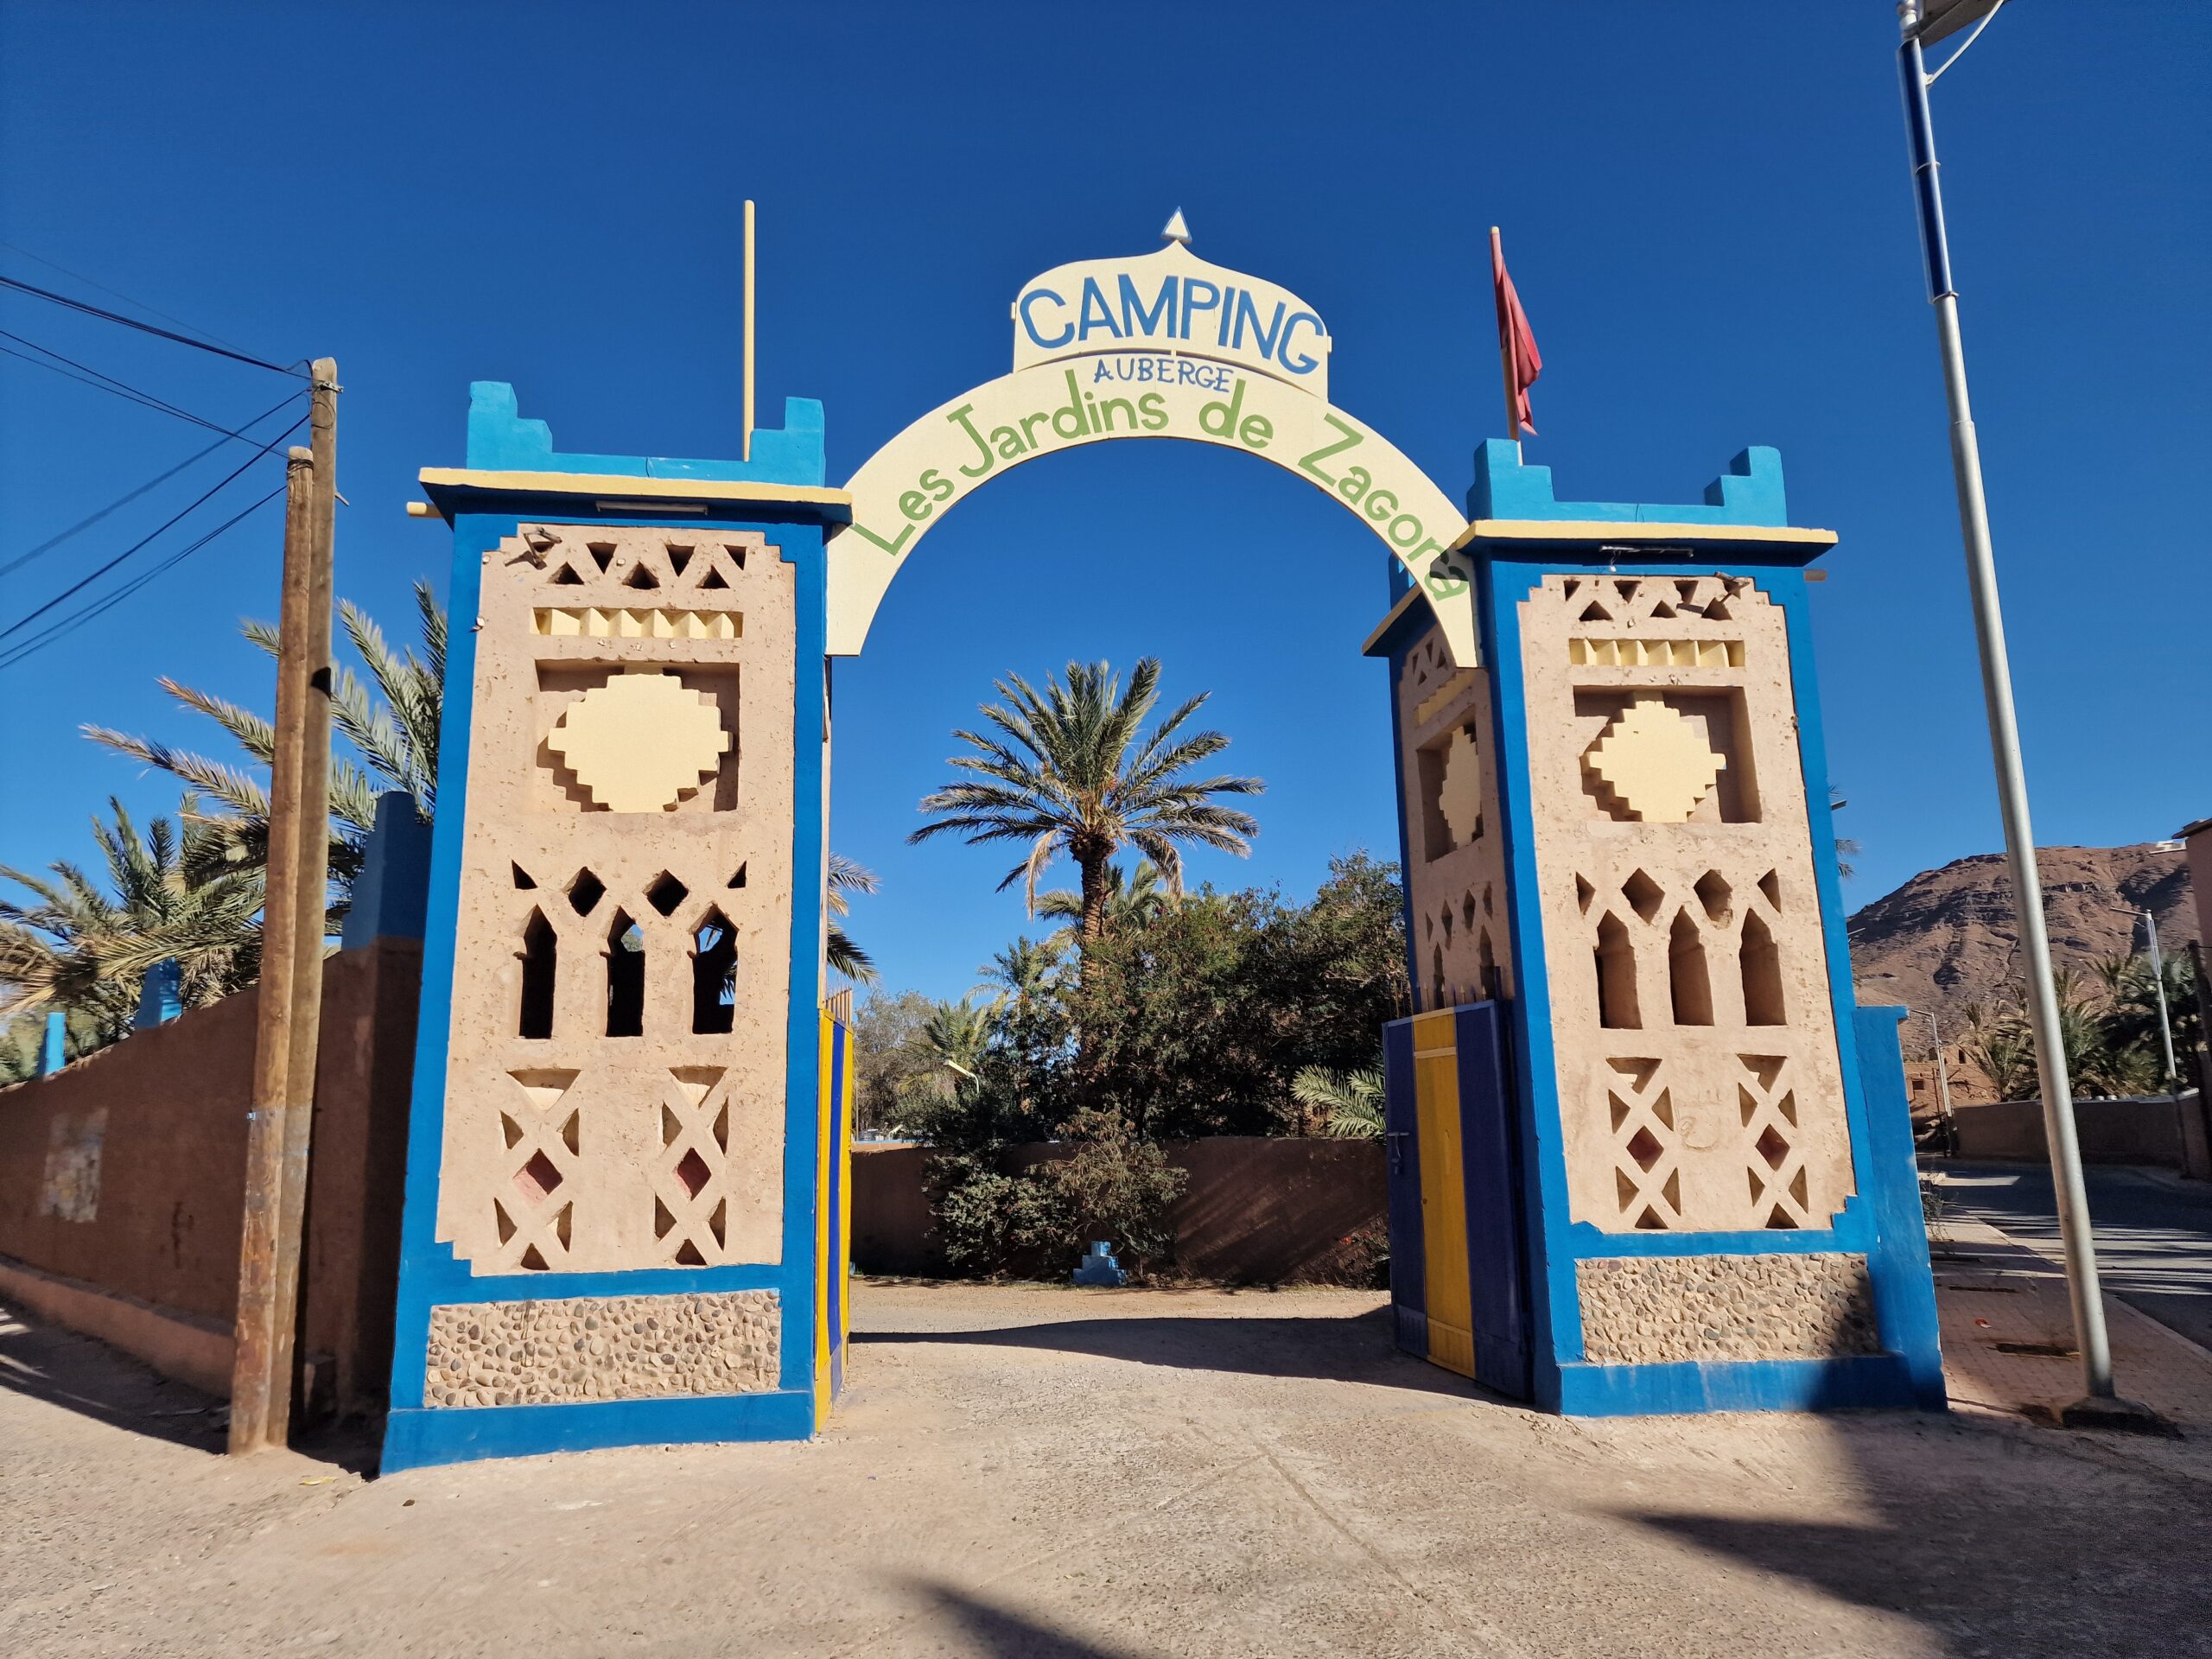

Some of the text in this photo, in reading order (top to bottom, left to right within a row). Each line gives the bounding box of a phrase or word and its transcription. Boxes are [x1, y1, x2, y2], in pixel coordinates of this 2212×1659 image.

[1020, 274, 1324, 374] CAMPING
[1094, 358, 1234, 392] AUBERGE
[851, 468, 955, 556] Les
[946, 369, 1169, 478] Jardins
[1198, 378, 1274, 448] de
